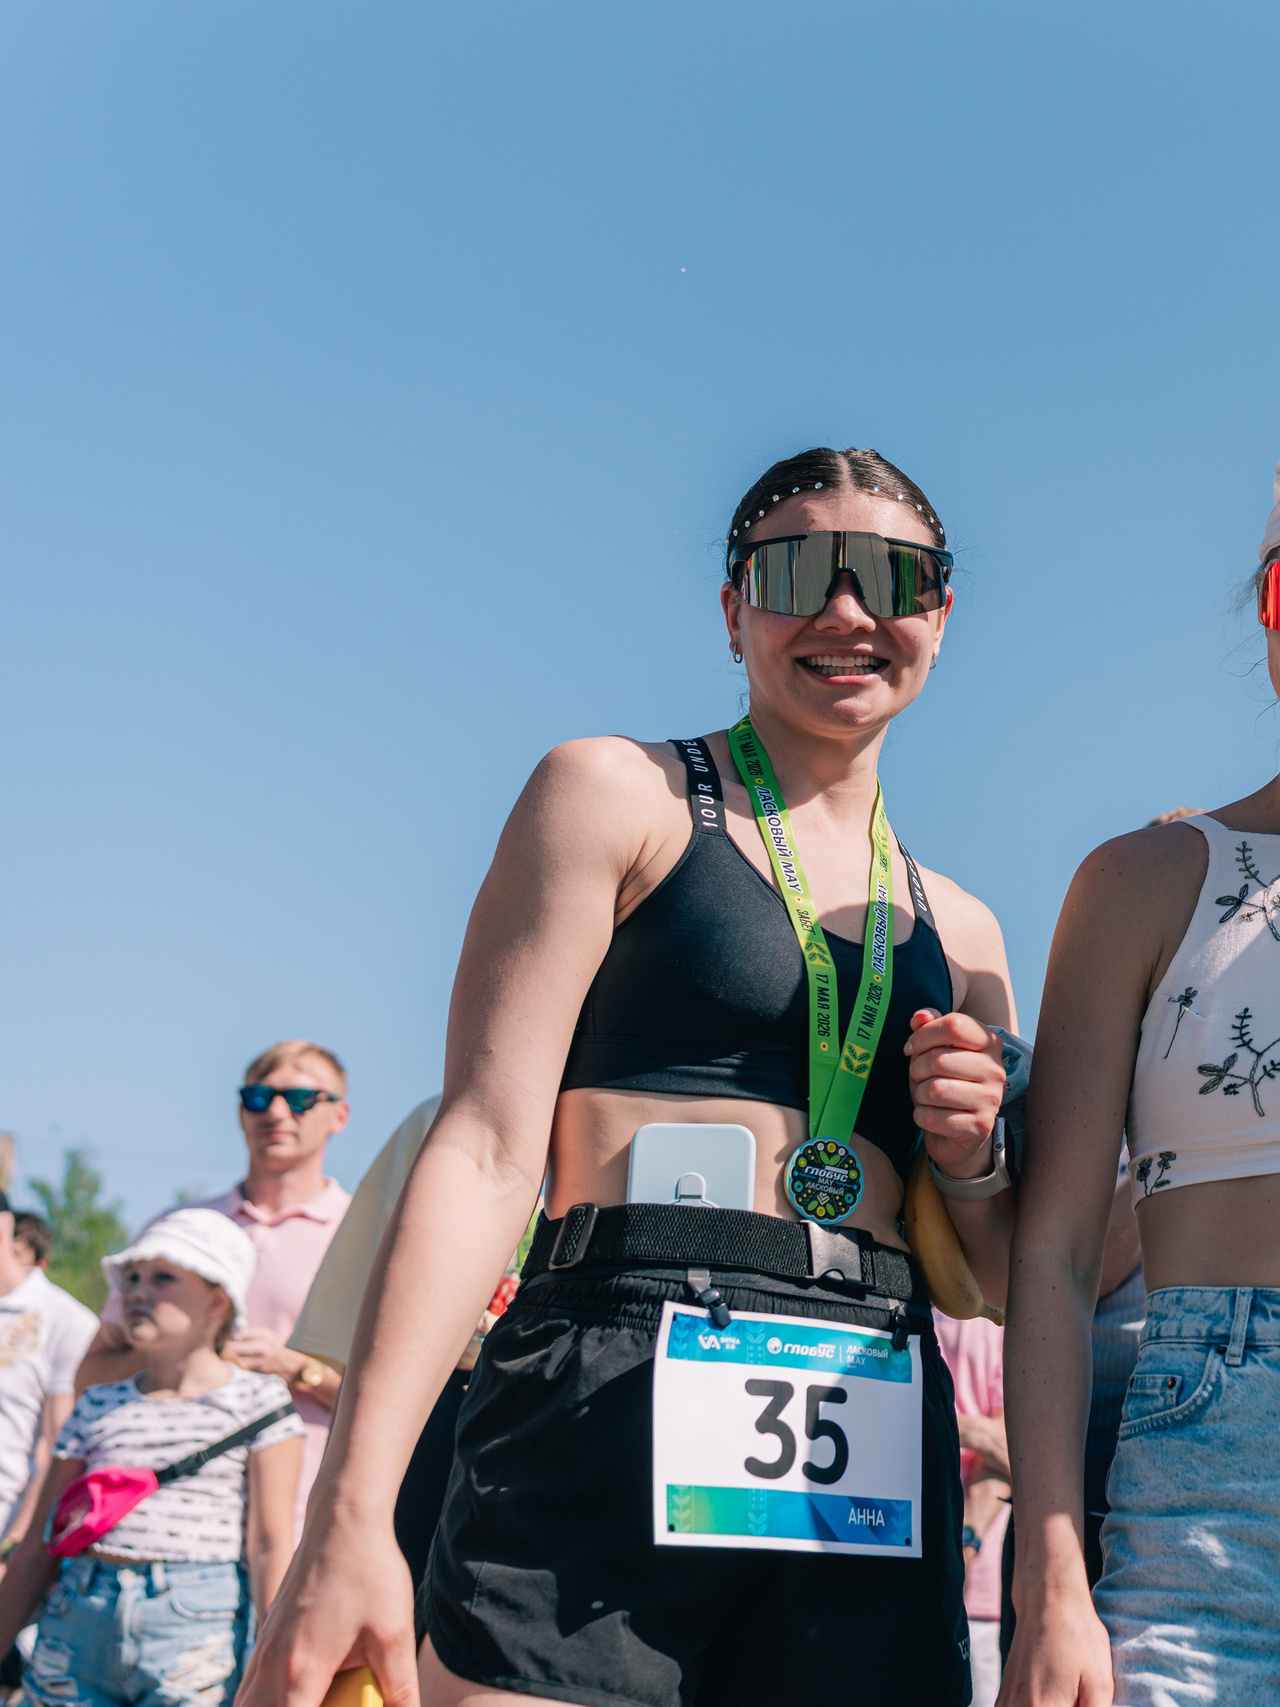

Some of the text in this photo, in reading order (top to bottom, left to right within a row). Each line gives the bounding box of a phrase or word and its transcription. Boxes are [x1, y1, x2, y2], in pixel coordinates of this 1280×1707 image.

[682, 741, 709, 772] UNDE
[737, 733, 763, 776] 17 МАЯ 2026
[755, 785, 794, 858] ЛАСКОВЫЙ
[871, 905, 888, 976] ЛАСКОВЫЙ
[816, 973, 831, 1037] 17 МАЯ 2026
[857, 983, 883, 1040] 17 МАЯ 2026
[804, 1166, 848, 1182] ГЛОБУС
[805, 1181, 844, 1196] ЛАСКОВЫЙ
[783, 1343, 835, 1359] ГЛОБУС
[847, 1345, 889, 1359] ЛАСКОВЫЙ
[744, 1378, 849, 1485] 35
[848, 1507, 885, 1527] АННА
